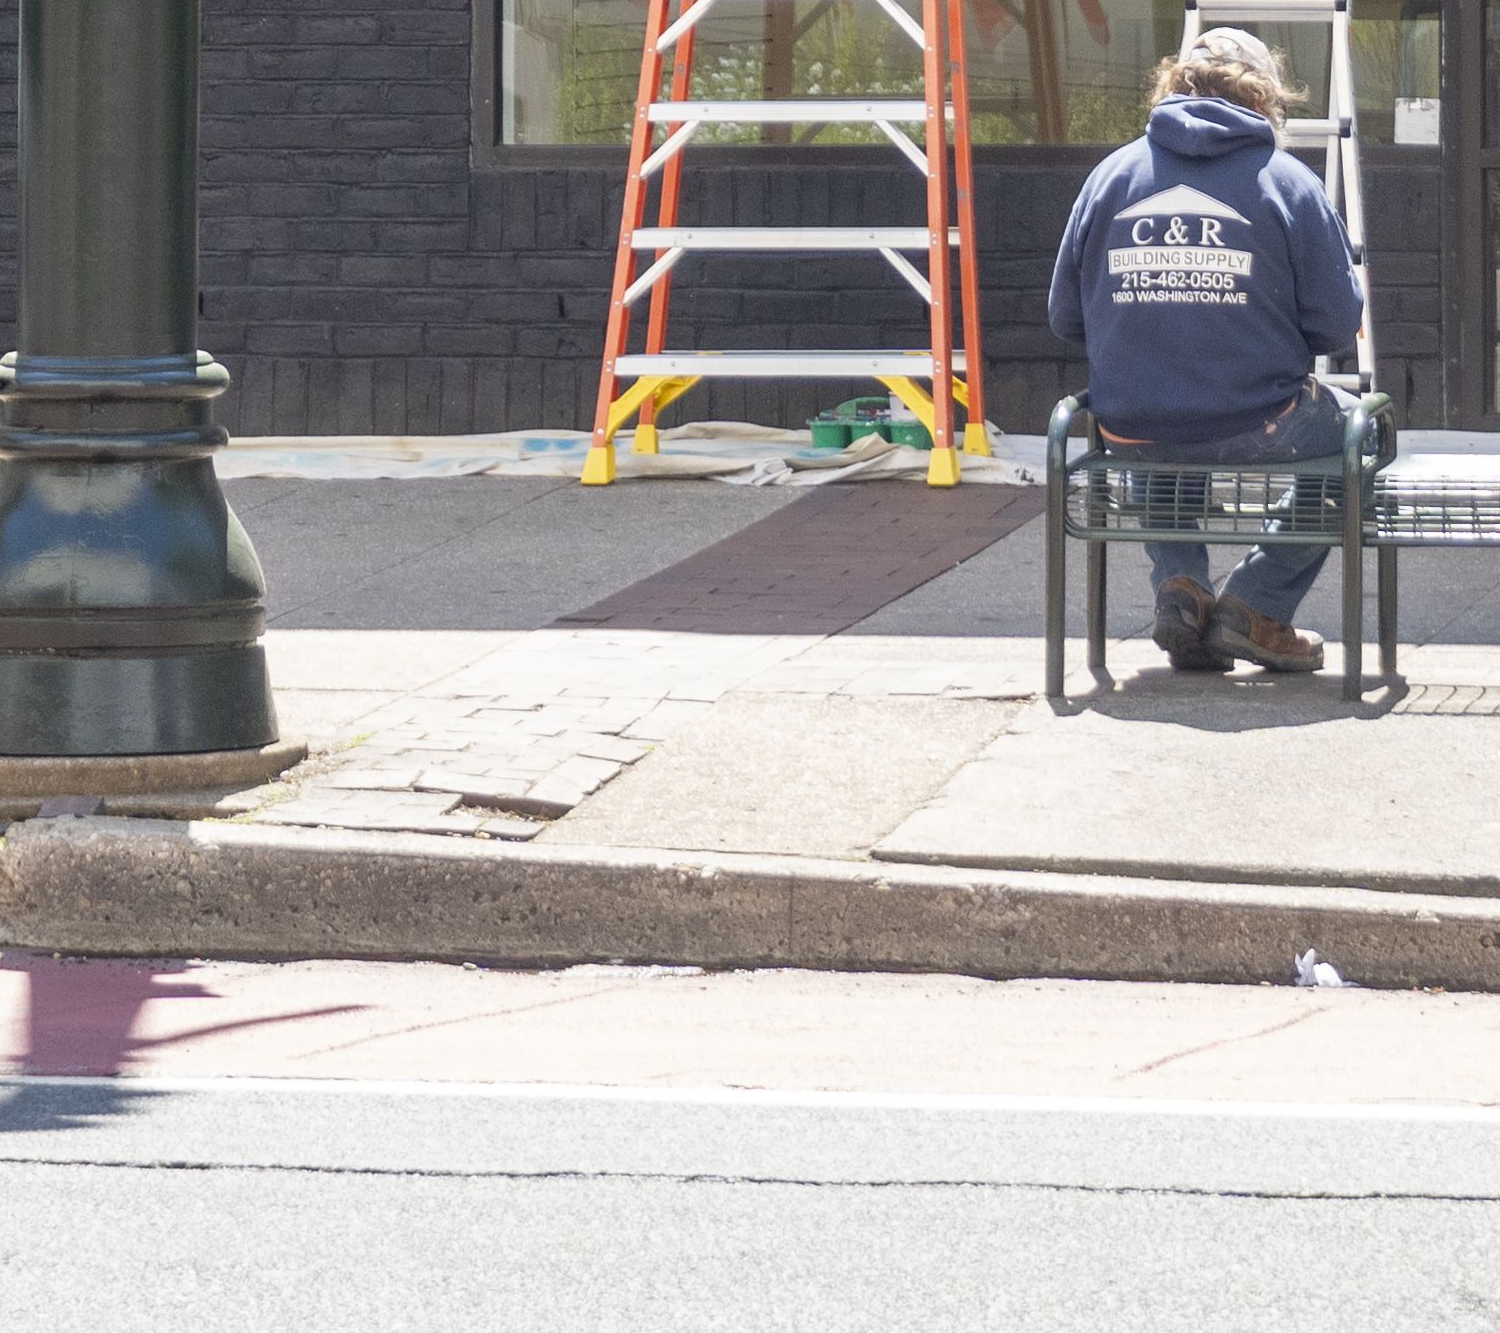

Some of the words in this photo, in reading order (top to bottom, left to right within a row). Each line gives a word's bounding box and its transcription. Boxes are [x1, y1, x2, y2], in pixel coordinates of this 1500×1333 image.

[1132, 217, 1155, 245] C
[1164, 216, 1189, 245] &
[1199, 217, 1226, 246] R
[1113, 251, 1181, 268] BUILDING
[1184, 252, 1247, 269] SUPPLY
[1121, 271, 1235, 290] 215-462-0505
[1112, 290, 1134, 303] 1600
[1136, 290, 1220, 303] WASHINGTON
[1222, 292, 1248, 304] AVE
